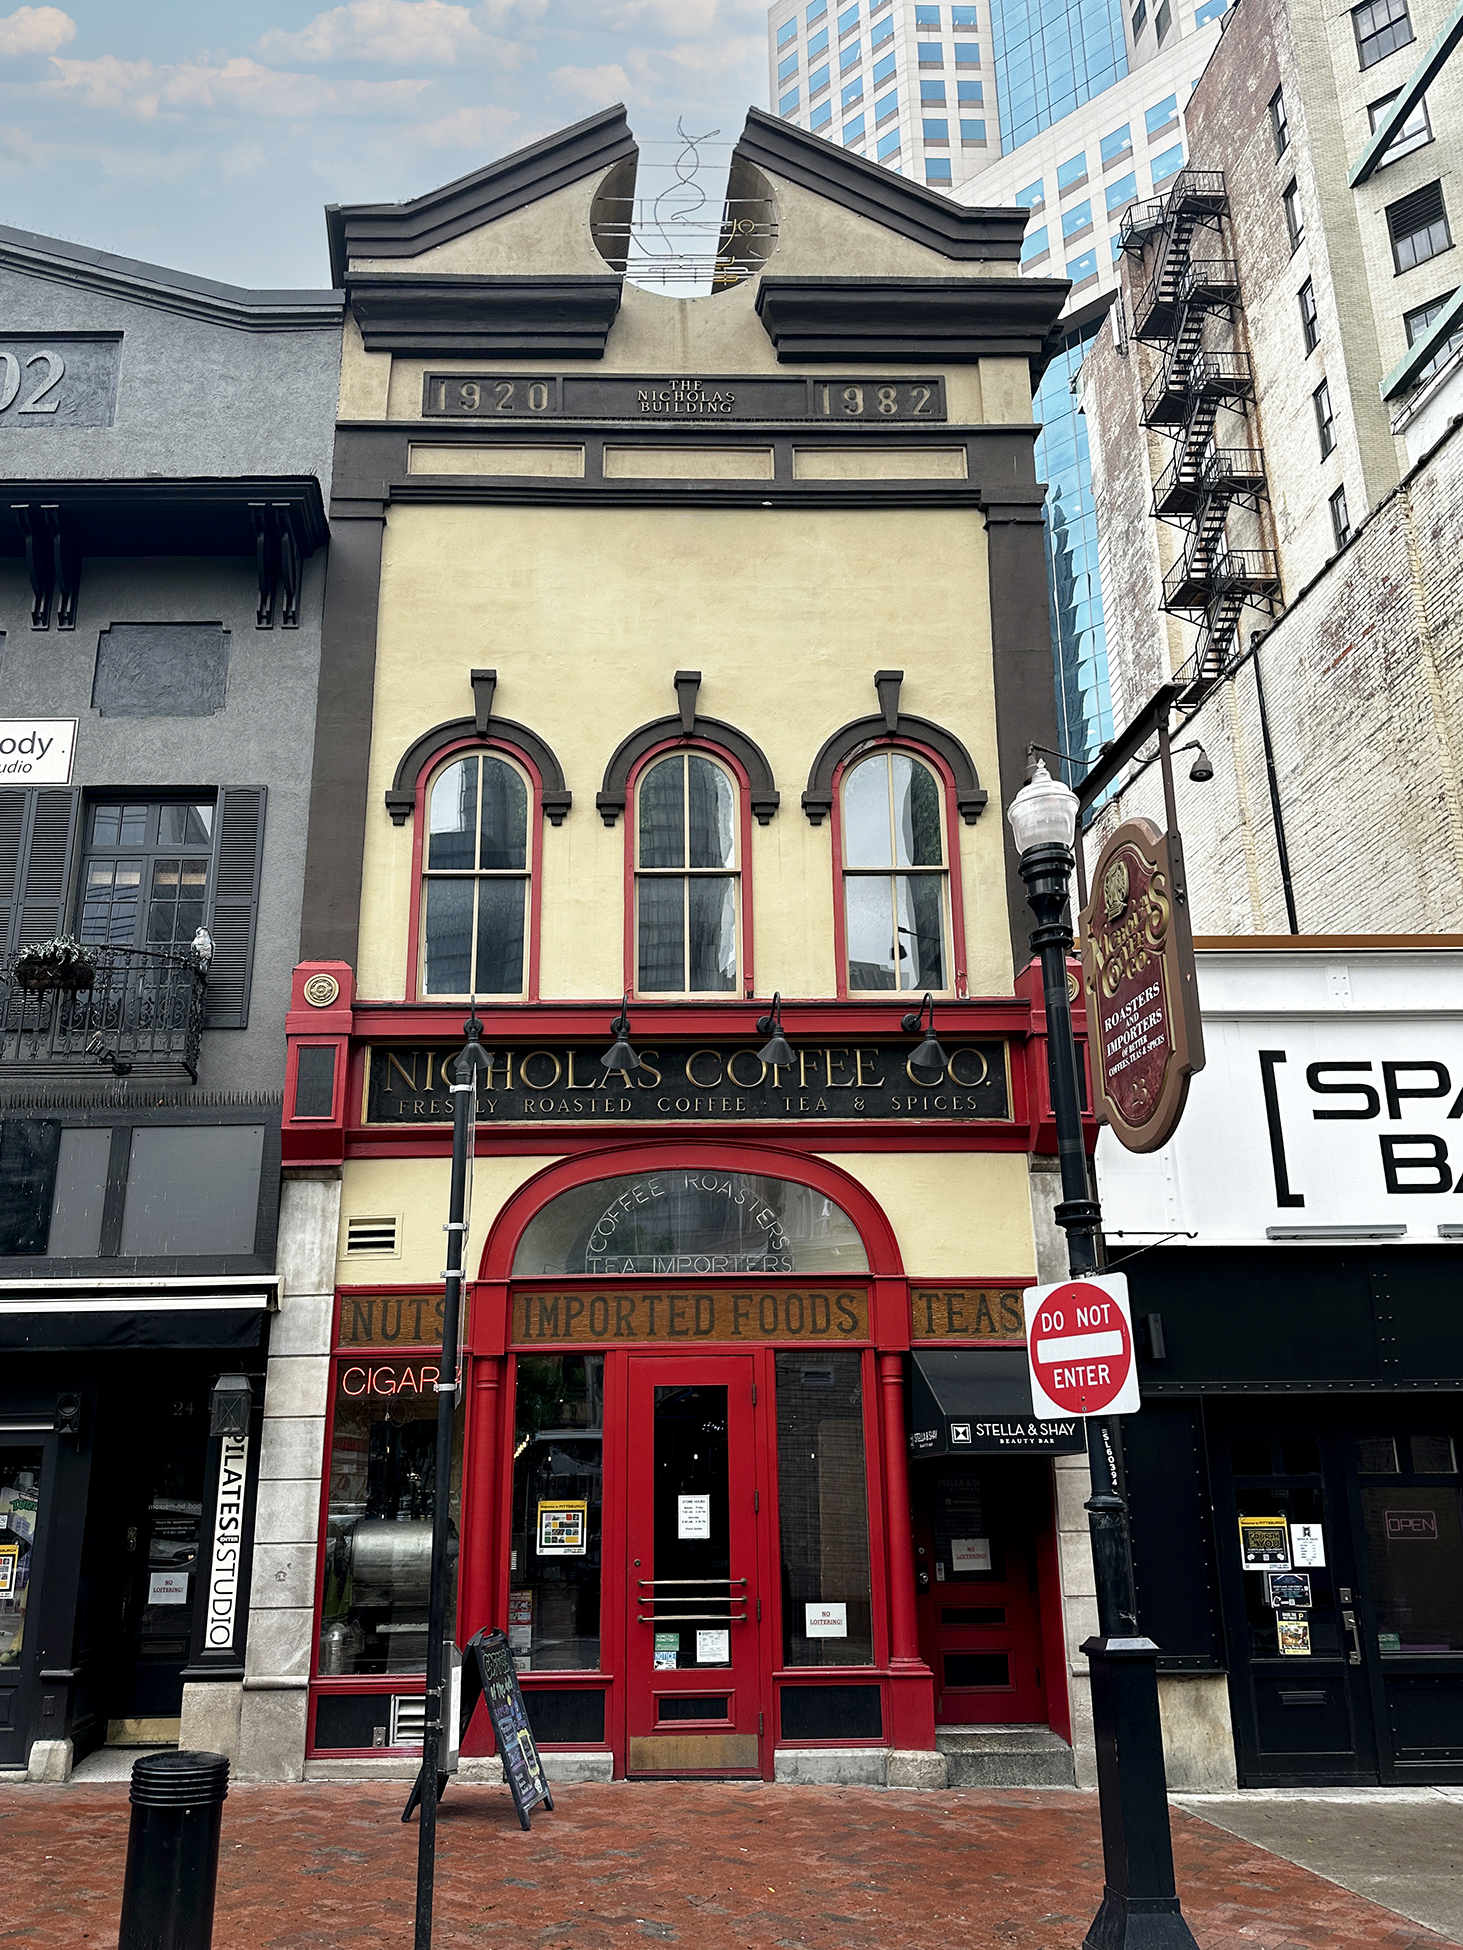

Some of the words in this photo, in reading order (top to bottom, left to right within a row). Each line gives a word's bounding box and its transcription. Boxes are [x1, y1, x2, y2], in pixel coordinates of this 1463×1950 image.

[438, 379, 549, 412] 1920
[637, 390, 735, 403] NICHOLAS
[668, 380, 703, 391] THE
[822, 383, 932, 415] 1982
[640, 402, 732, 414] BUILDING
[1104, 981, 1160, 1033] ROASTERS
[1125, 1012, 1140, 1028] AND
[1106, 1007, 1163, 1058] IMPORTERS
[1121, 1048, 1129, 1058] OF
[1128, 1034, 1148, 1055] BETTER
[1129, 1049, 1142, 1063] TEAS
[1147, 1033, 1165, 1053] SPICES
[685, 1048, 886, 1089] COFFEE
[905, 1048, 993, 1088] CO.
[398, 1099, 500, 1115] FRESLY
[523, 1097, 632, 1114] ROASTED
[657, 1096, 747, 1113] COFFEE
[782, 1096, 829, 1112] TEA
[853, 1099, 866, 1112] &
[890, 1095, 978, 1111] SPICES
[1306, 1061, 1463, 1120] SP
[1379, 1134, 1463, 1194] B
[588, 1176, 665, 1253] COFFEE
[683, 1173, 791, 1252] ROASTERS
[587, 1257, 637, 1274] TEA
[652, 1255, 793, 1273] IMPORTERS
[522, 1293, 717, 1339] IMPORTED
[730, 1292, 859, 1335] FOODS
[918, 1292, 1024, 1334] TEAS
[1041, 1310, 1065, 1333] DO
[1076, 1303, 1111, 1328] NOT
[342, 1366, 461, 1396] CIGAR
[1053, 1364, 1111, 1389] ENTER
[173, 1401, 194, 1415] 24
[976, 1422, 1026, 1437] STELLA
[1027, 1422, 1039, 1436] &
[1040, 1422, 1076, 1436] SHAY
[1388, 1518, 1436, 1532] OPEN
[209, 1548, 237, 1646] STUDIO
